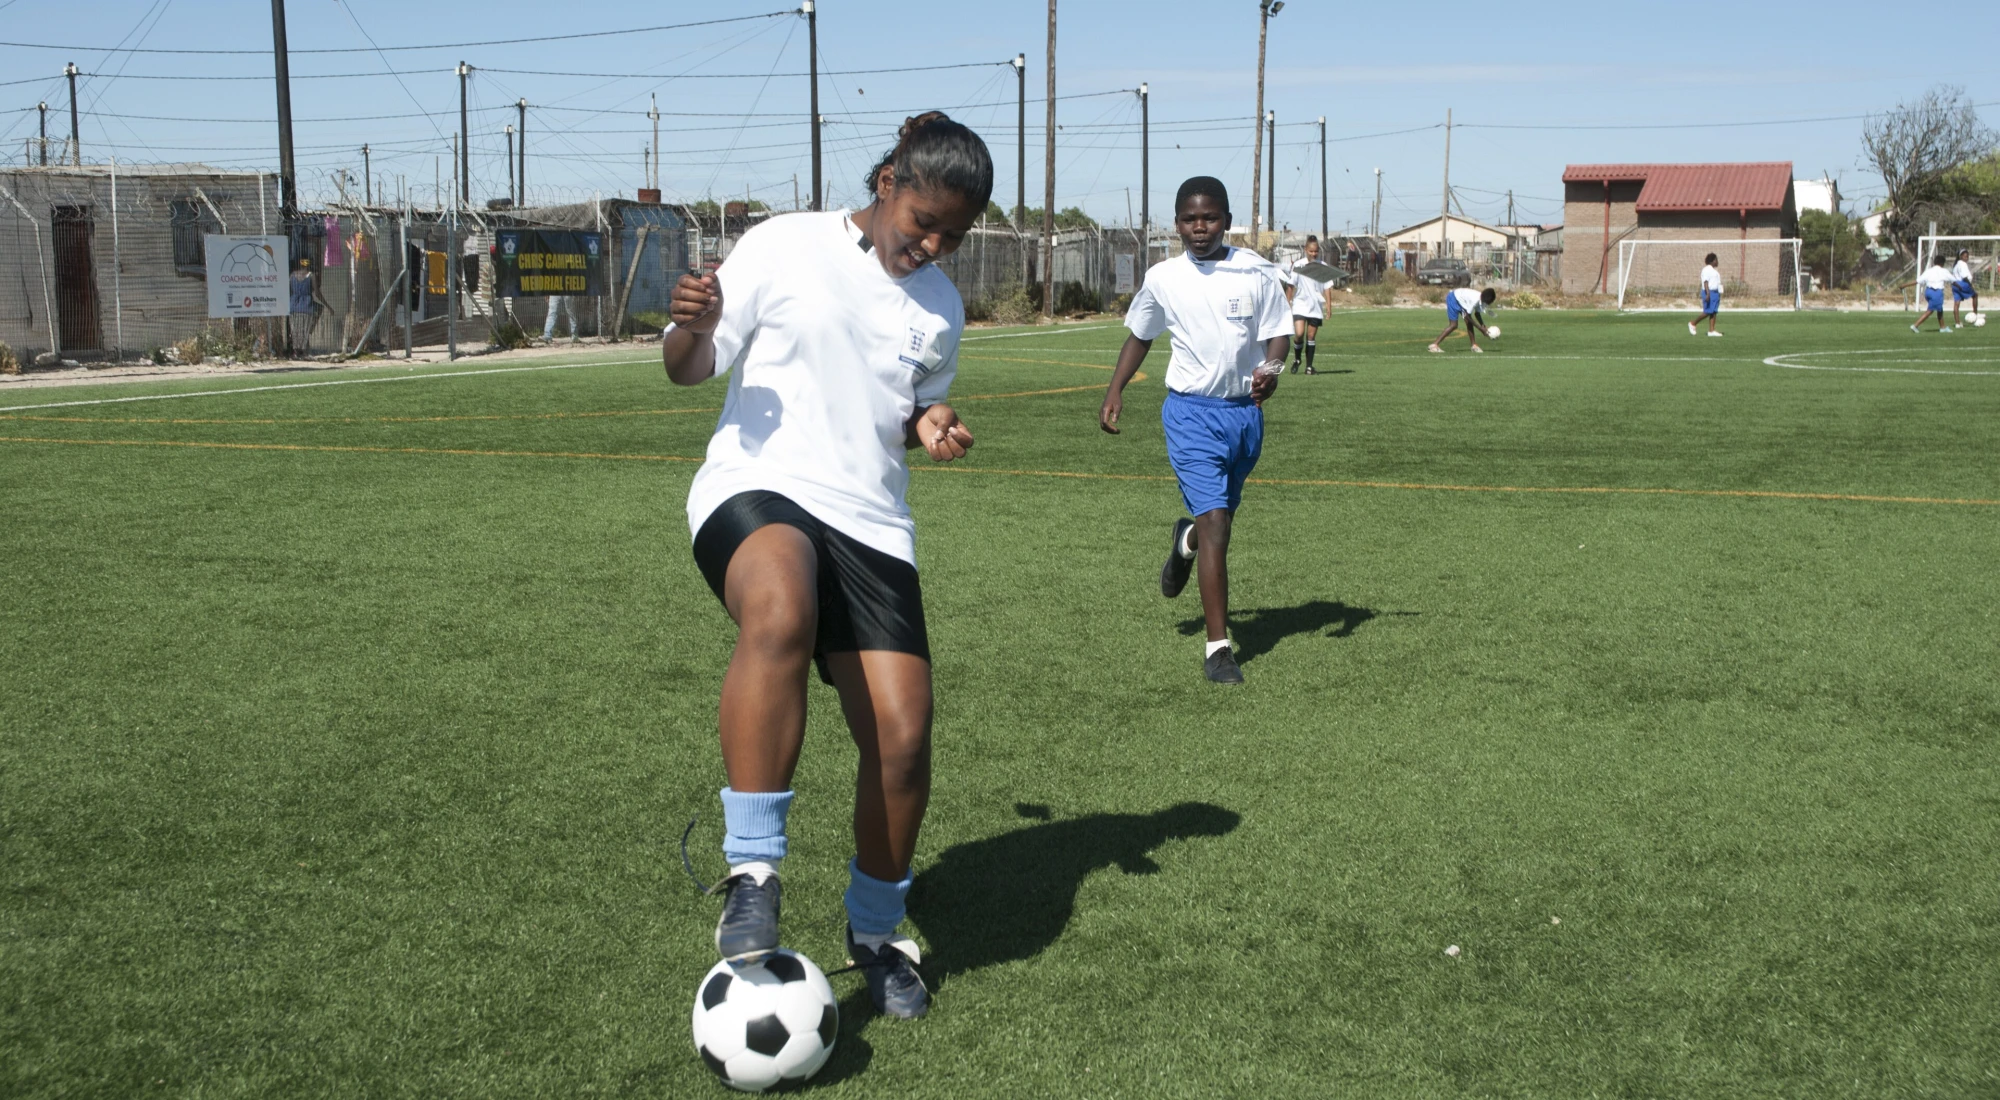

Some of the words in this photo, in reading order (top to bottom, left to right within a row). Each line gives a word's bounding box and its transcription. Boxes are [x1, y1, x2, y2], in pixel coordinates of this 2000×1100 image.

[518, 253, 544, 269] CHRIS
[545, 253, 587, 269] CAMPBELL
[221, 275, 253, 283] COACHING
[264, 274, 278, 282] HOPE
[520, 275, 564, 291] MEMORIAL
[565, 275, 586, 291] FIELD
